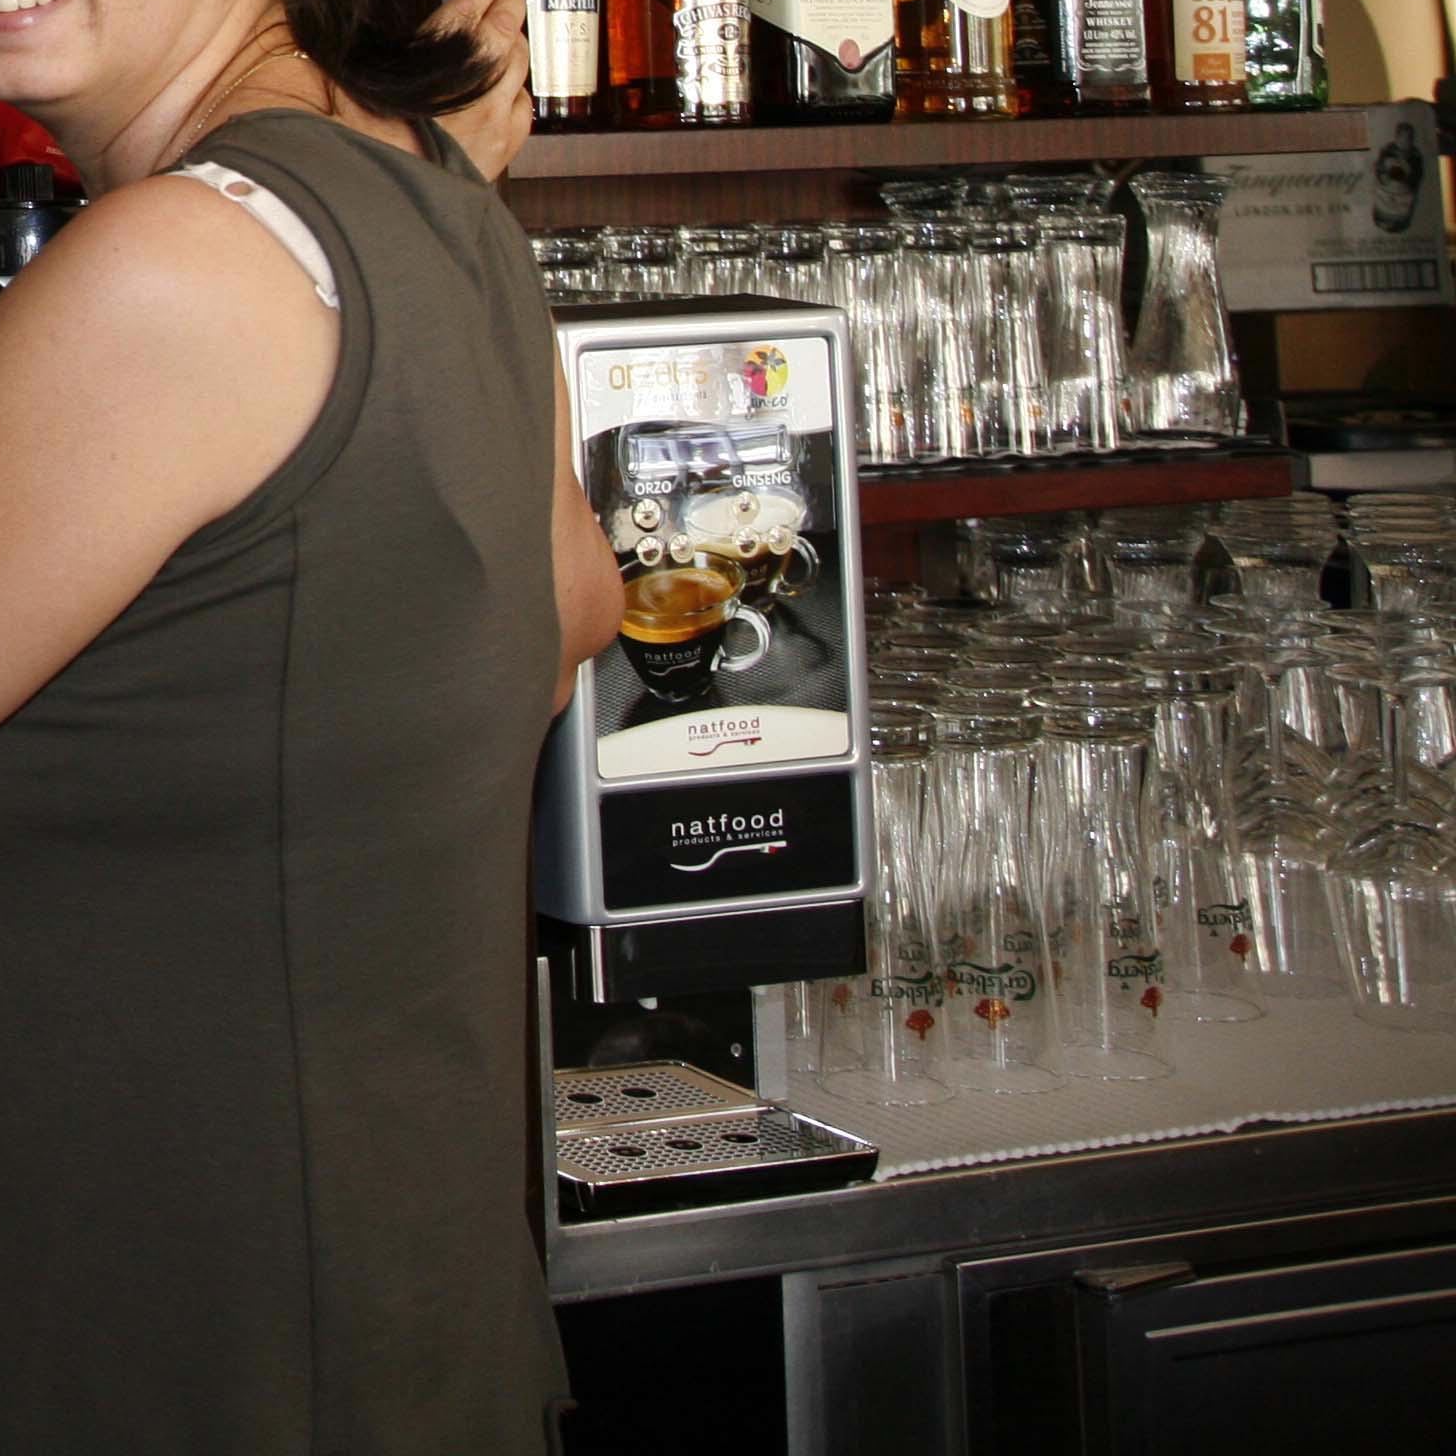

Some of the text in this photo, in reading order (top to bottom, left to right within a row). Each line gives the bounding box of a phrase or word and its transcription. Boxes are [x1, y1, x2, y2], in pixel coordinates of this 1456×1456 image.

[1085, 16, 1134, 26] WHISKEY
[1192, 6, 1230, 43] 81
[634, 480, 672, 495] ORZO
[733, 473, 792, 488] GINSENG
[644, 647, 701, 661] natfood
[688, 717, 760, 735] natfood
[671, 808, 784, 837] natfood
[672, 828, 784, 847] products & services
[947, 970, 1036, 1002] Carlsberg
